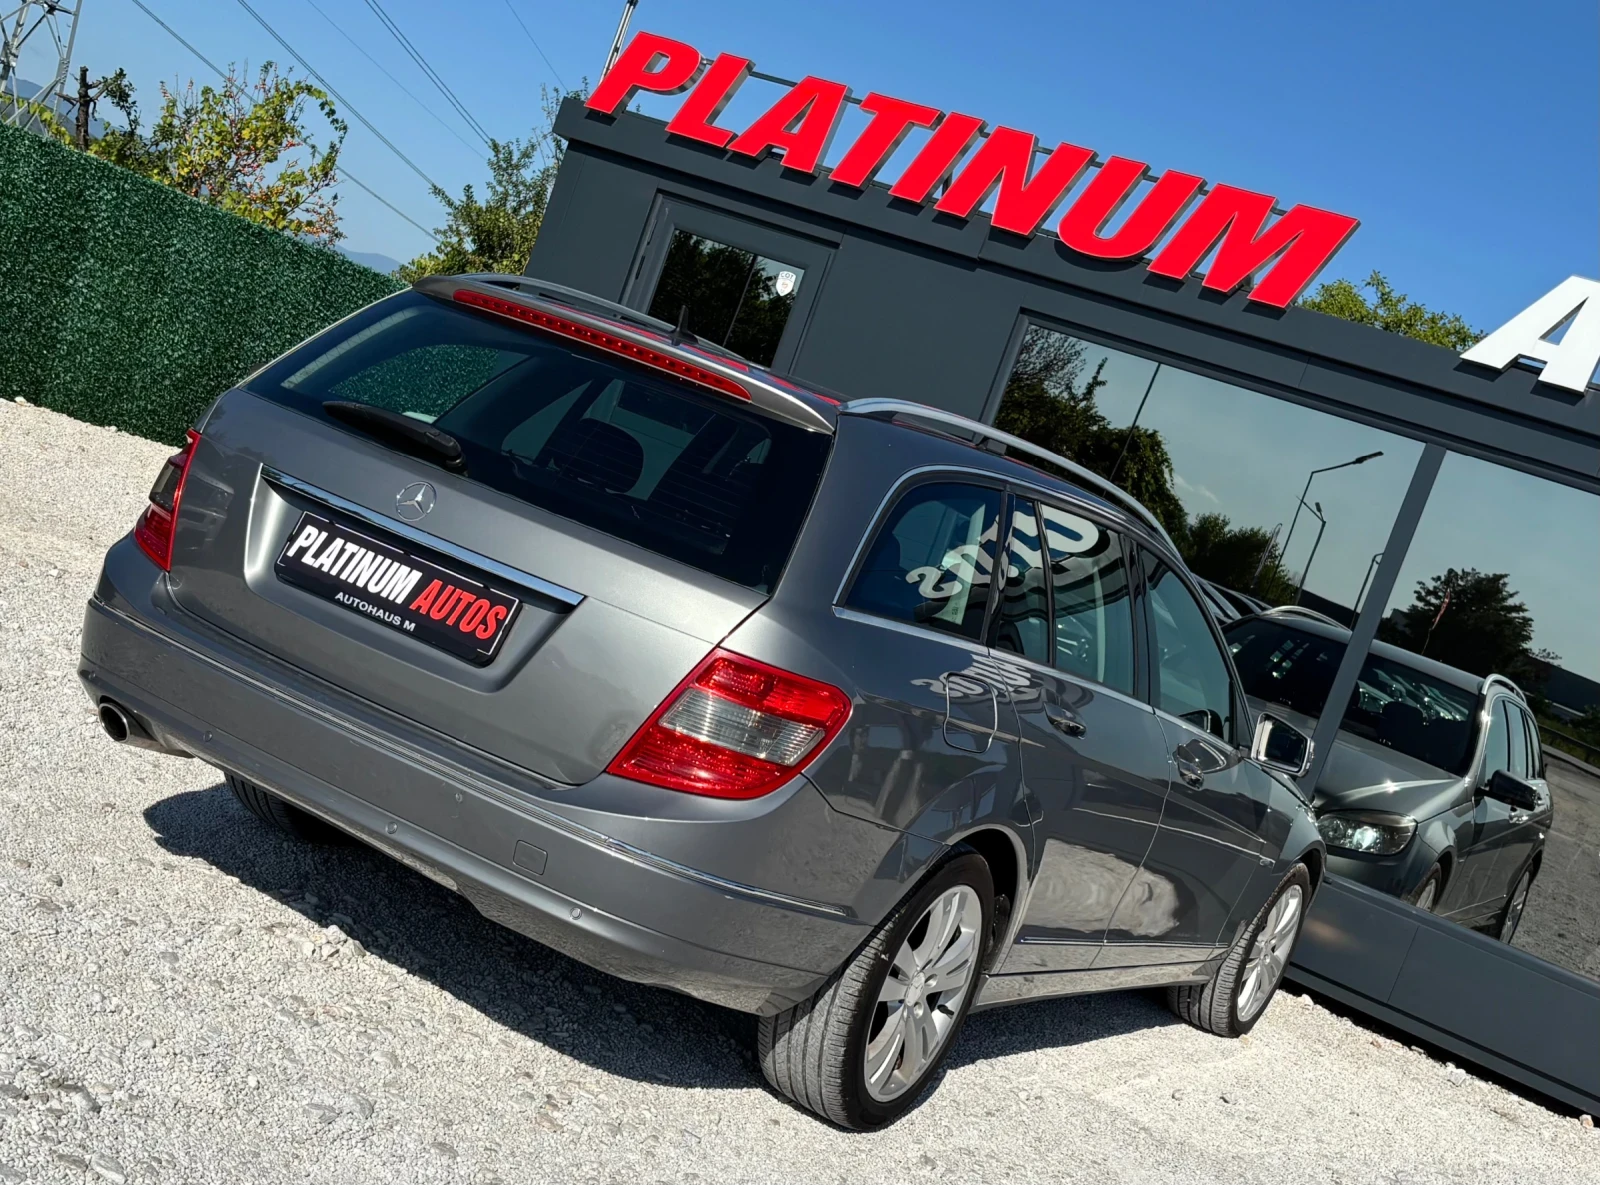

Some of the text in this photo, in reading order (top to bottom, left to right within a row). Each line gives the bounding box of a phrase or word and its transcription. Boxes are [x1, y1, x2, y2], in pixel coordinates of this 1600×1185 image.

[585, 31, 1359, 308] PLATINUM
[286, 524, 508, 640] PLATINUM AUTOS
[334, 591, 416, 632] AUTOHAUS M
